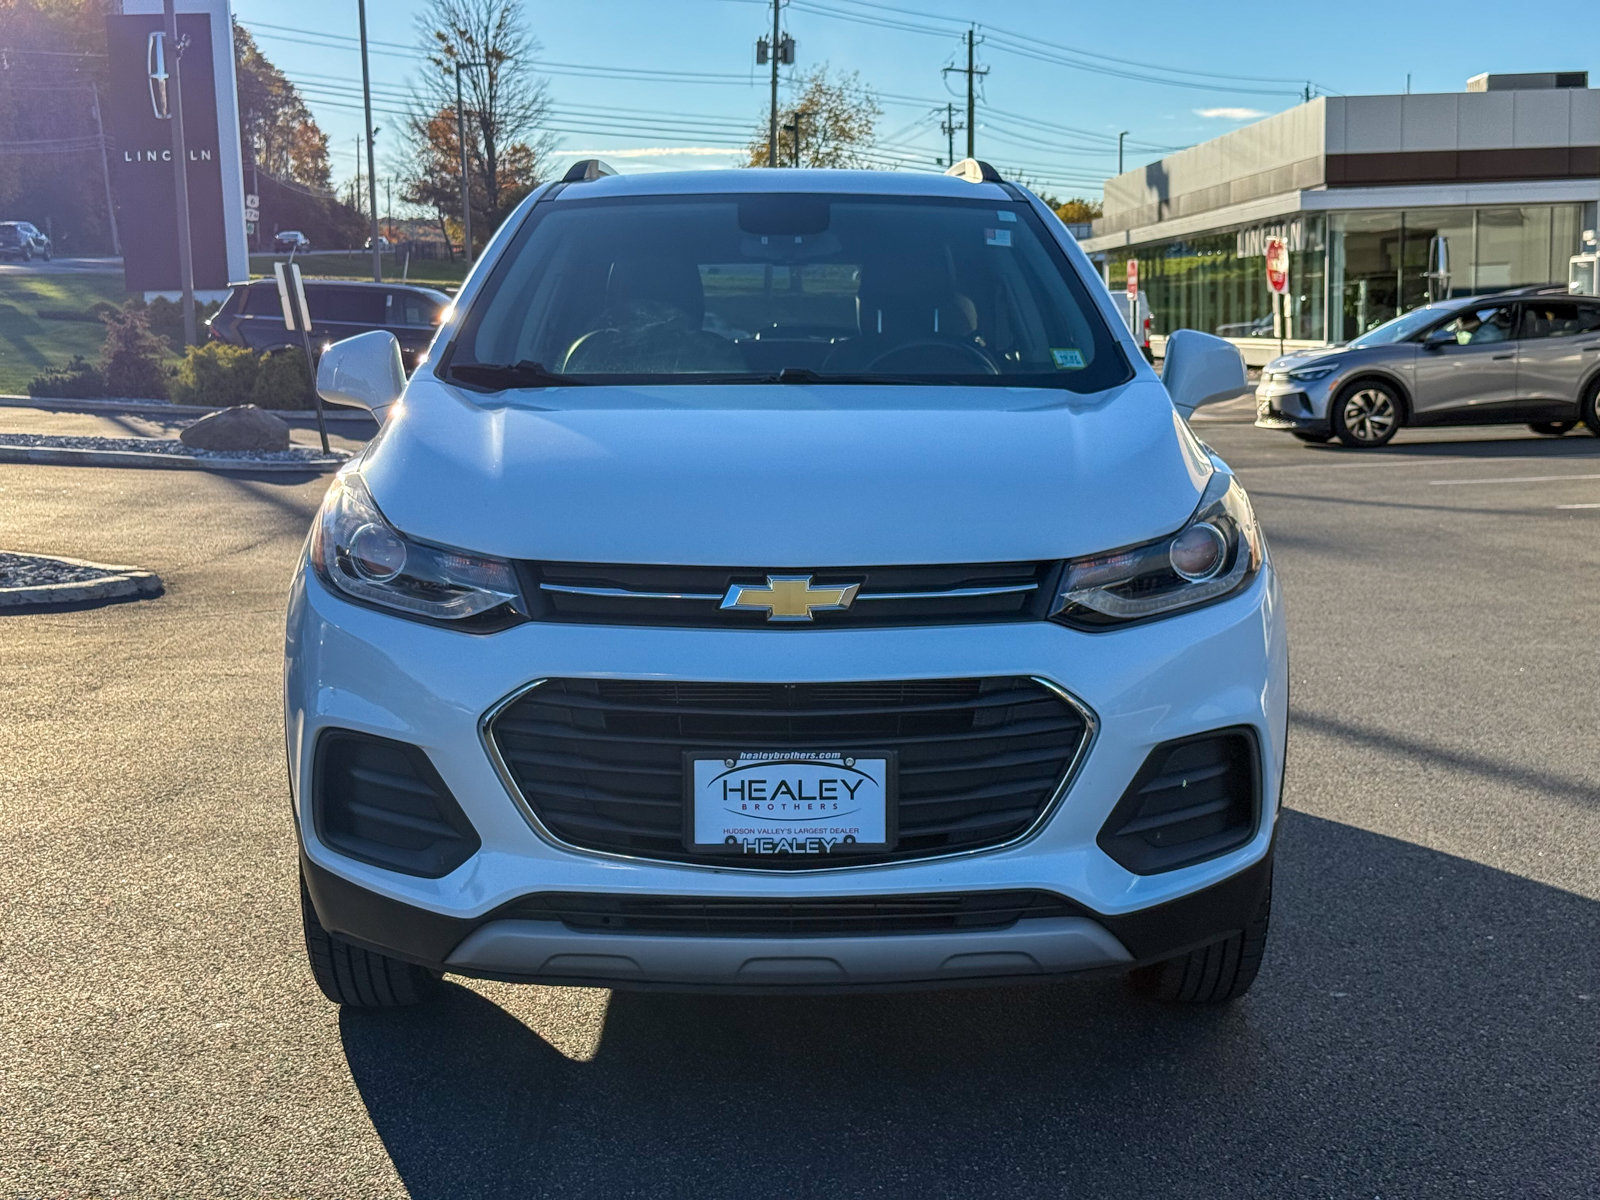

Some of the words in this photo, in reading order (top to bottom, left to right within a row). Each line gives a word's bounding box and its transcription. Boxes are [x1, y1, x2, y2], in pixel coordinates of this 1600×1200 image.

[124, 149, 211, 162] LINCLN
[739, 751, 841, 760] healeybrothers.com
[723, 778, 865, 801] HEALEY
[741, 803, 839, 811] BROTHERS
[723, 827, 755, 835] HUDSON
[757, 827, 792, 835] VALLEY'S
[793, 827, 828, 835] LARGEST
[743, 837, 838, 854] HEALEY
